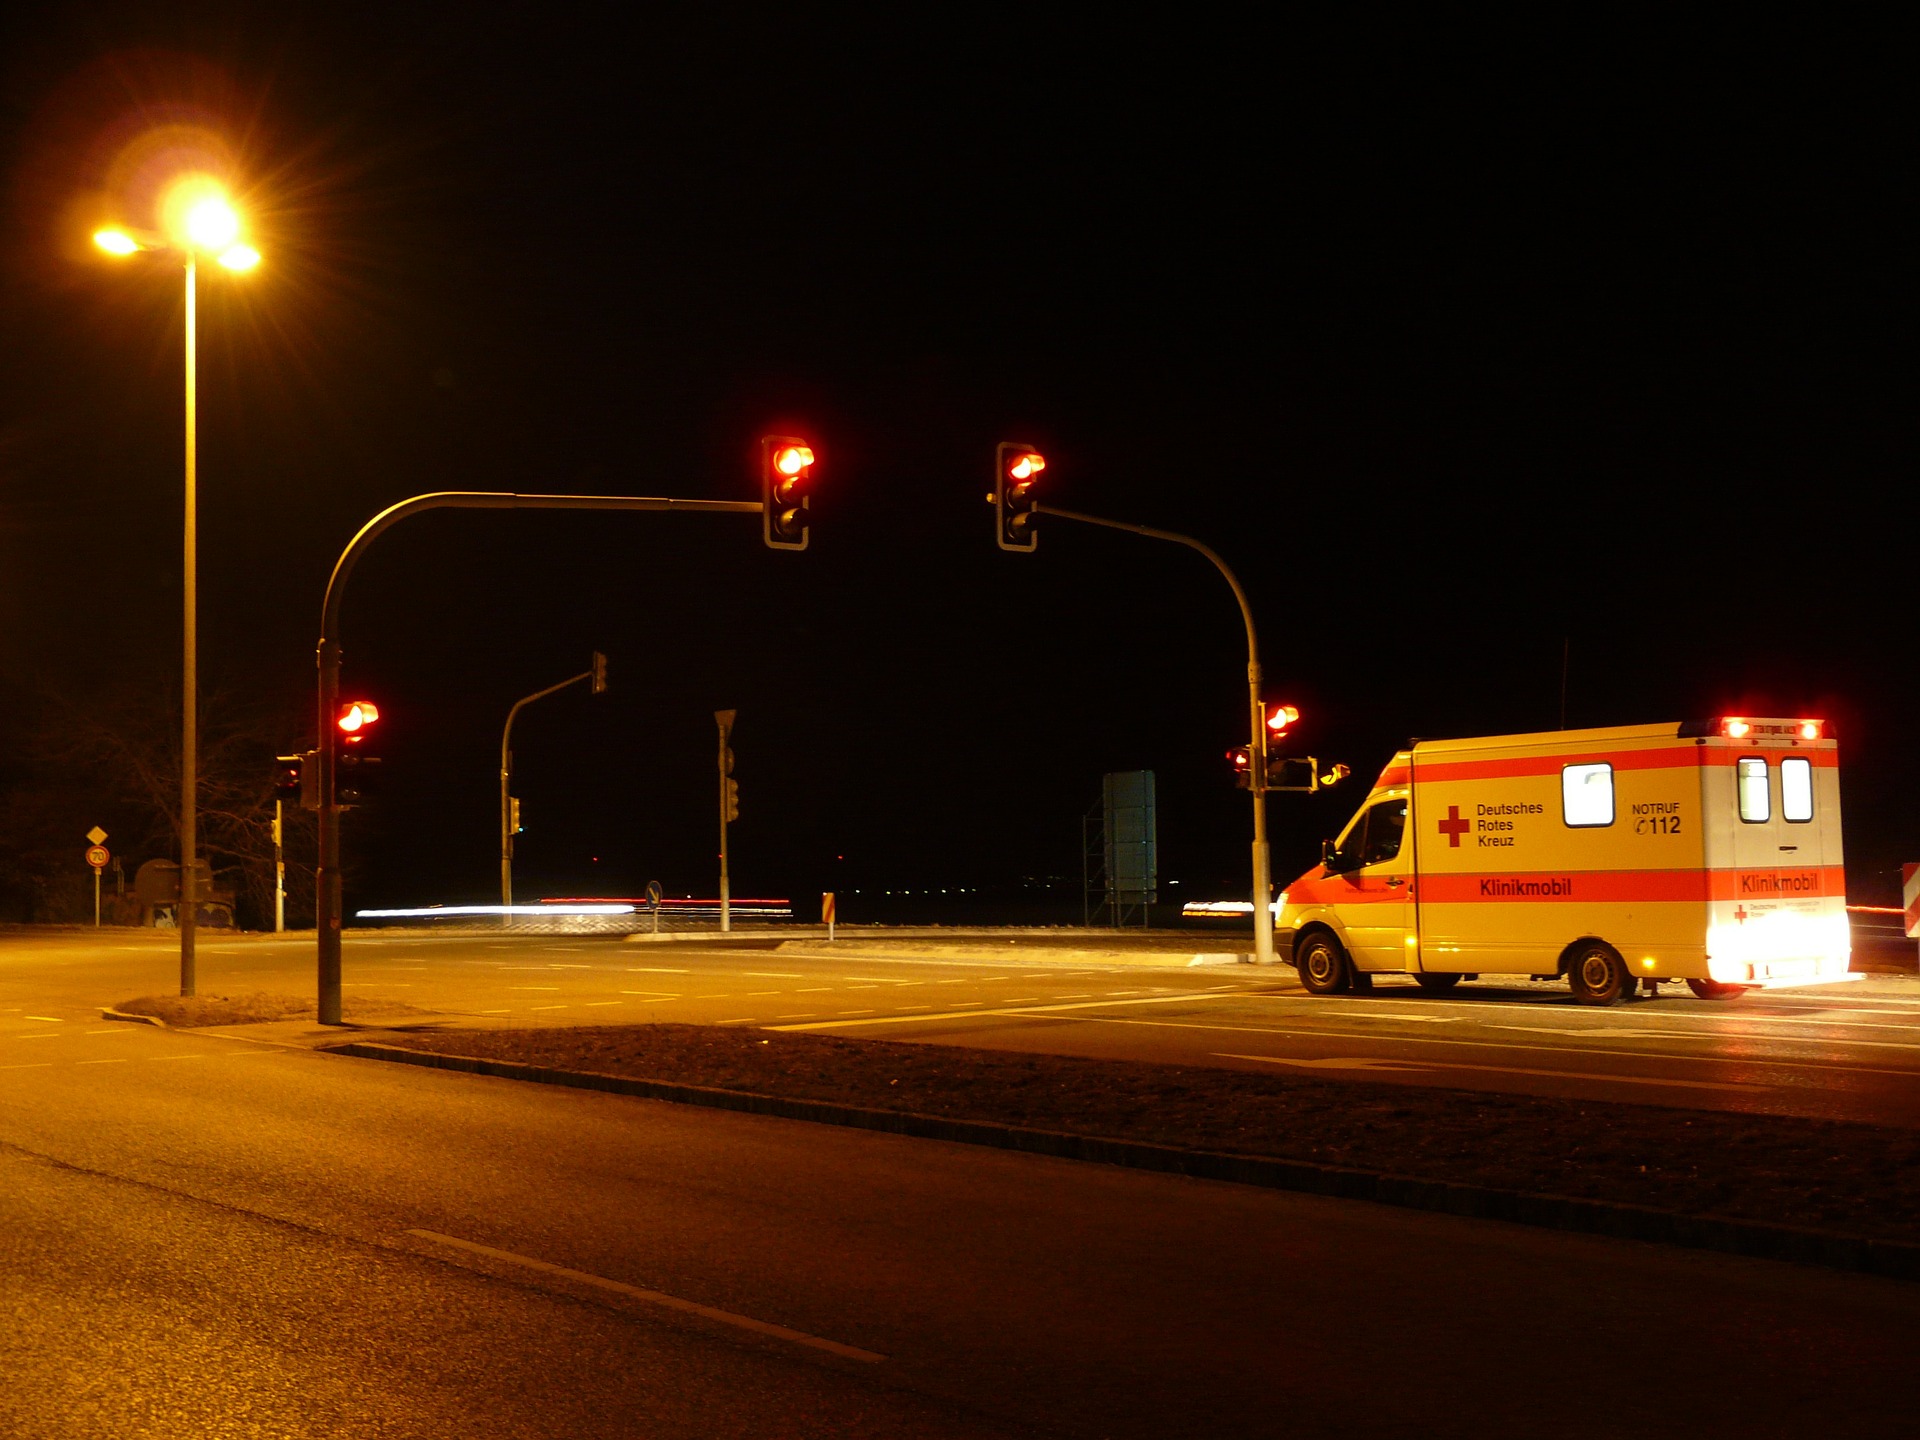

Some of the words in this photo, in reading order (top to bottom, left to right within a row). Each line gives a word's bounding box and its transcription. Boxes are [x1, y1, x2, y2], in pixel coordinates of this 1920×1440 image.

[1477, 802, 1543, 816] Deutsches
[1632, 802, 1680, 815] NOTRUF
[1477, 819, 1514, 832] Rotes
[1649, 815, 1681, 834] 112
[1478, 835, 1514, 847] Kreuz
[92, 851, 105, 861] 70
[1480, 878, 1572, 896] Klinikmobil
[1741, 873, 1818, 893] Klinikmobil
